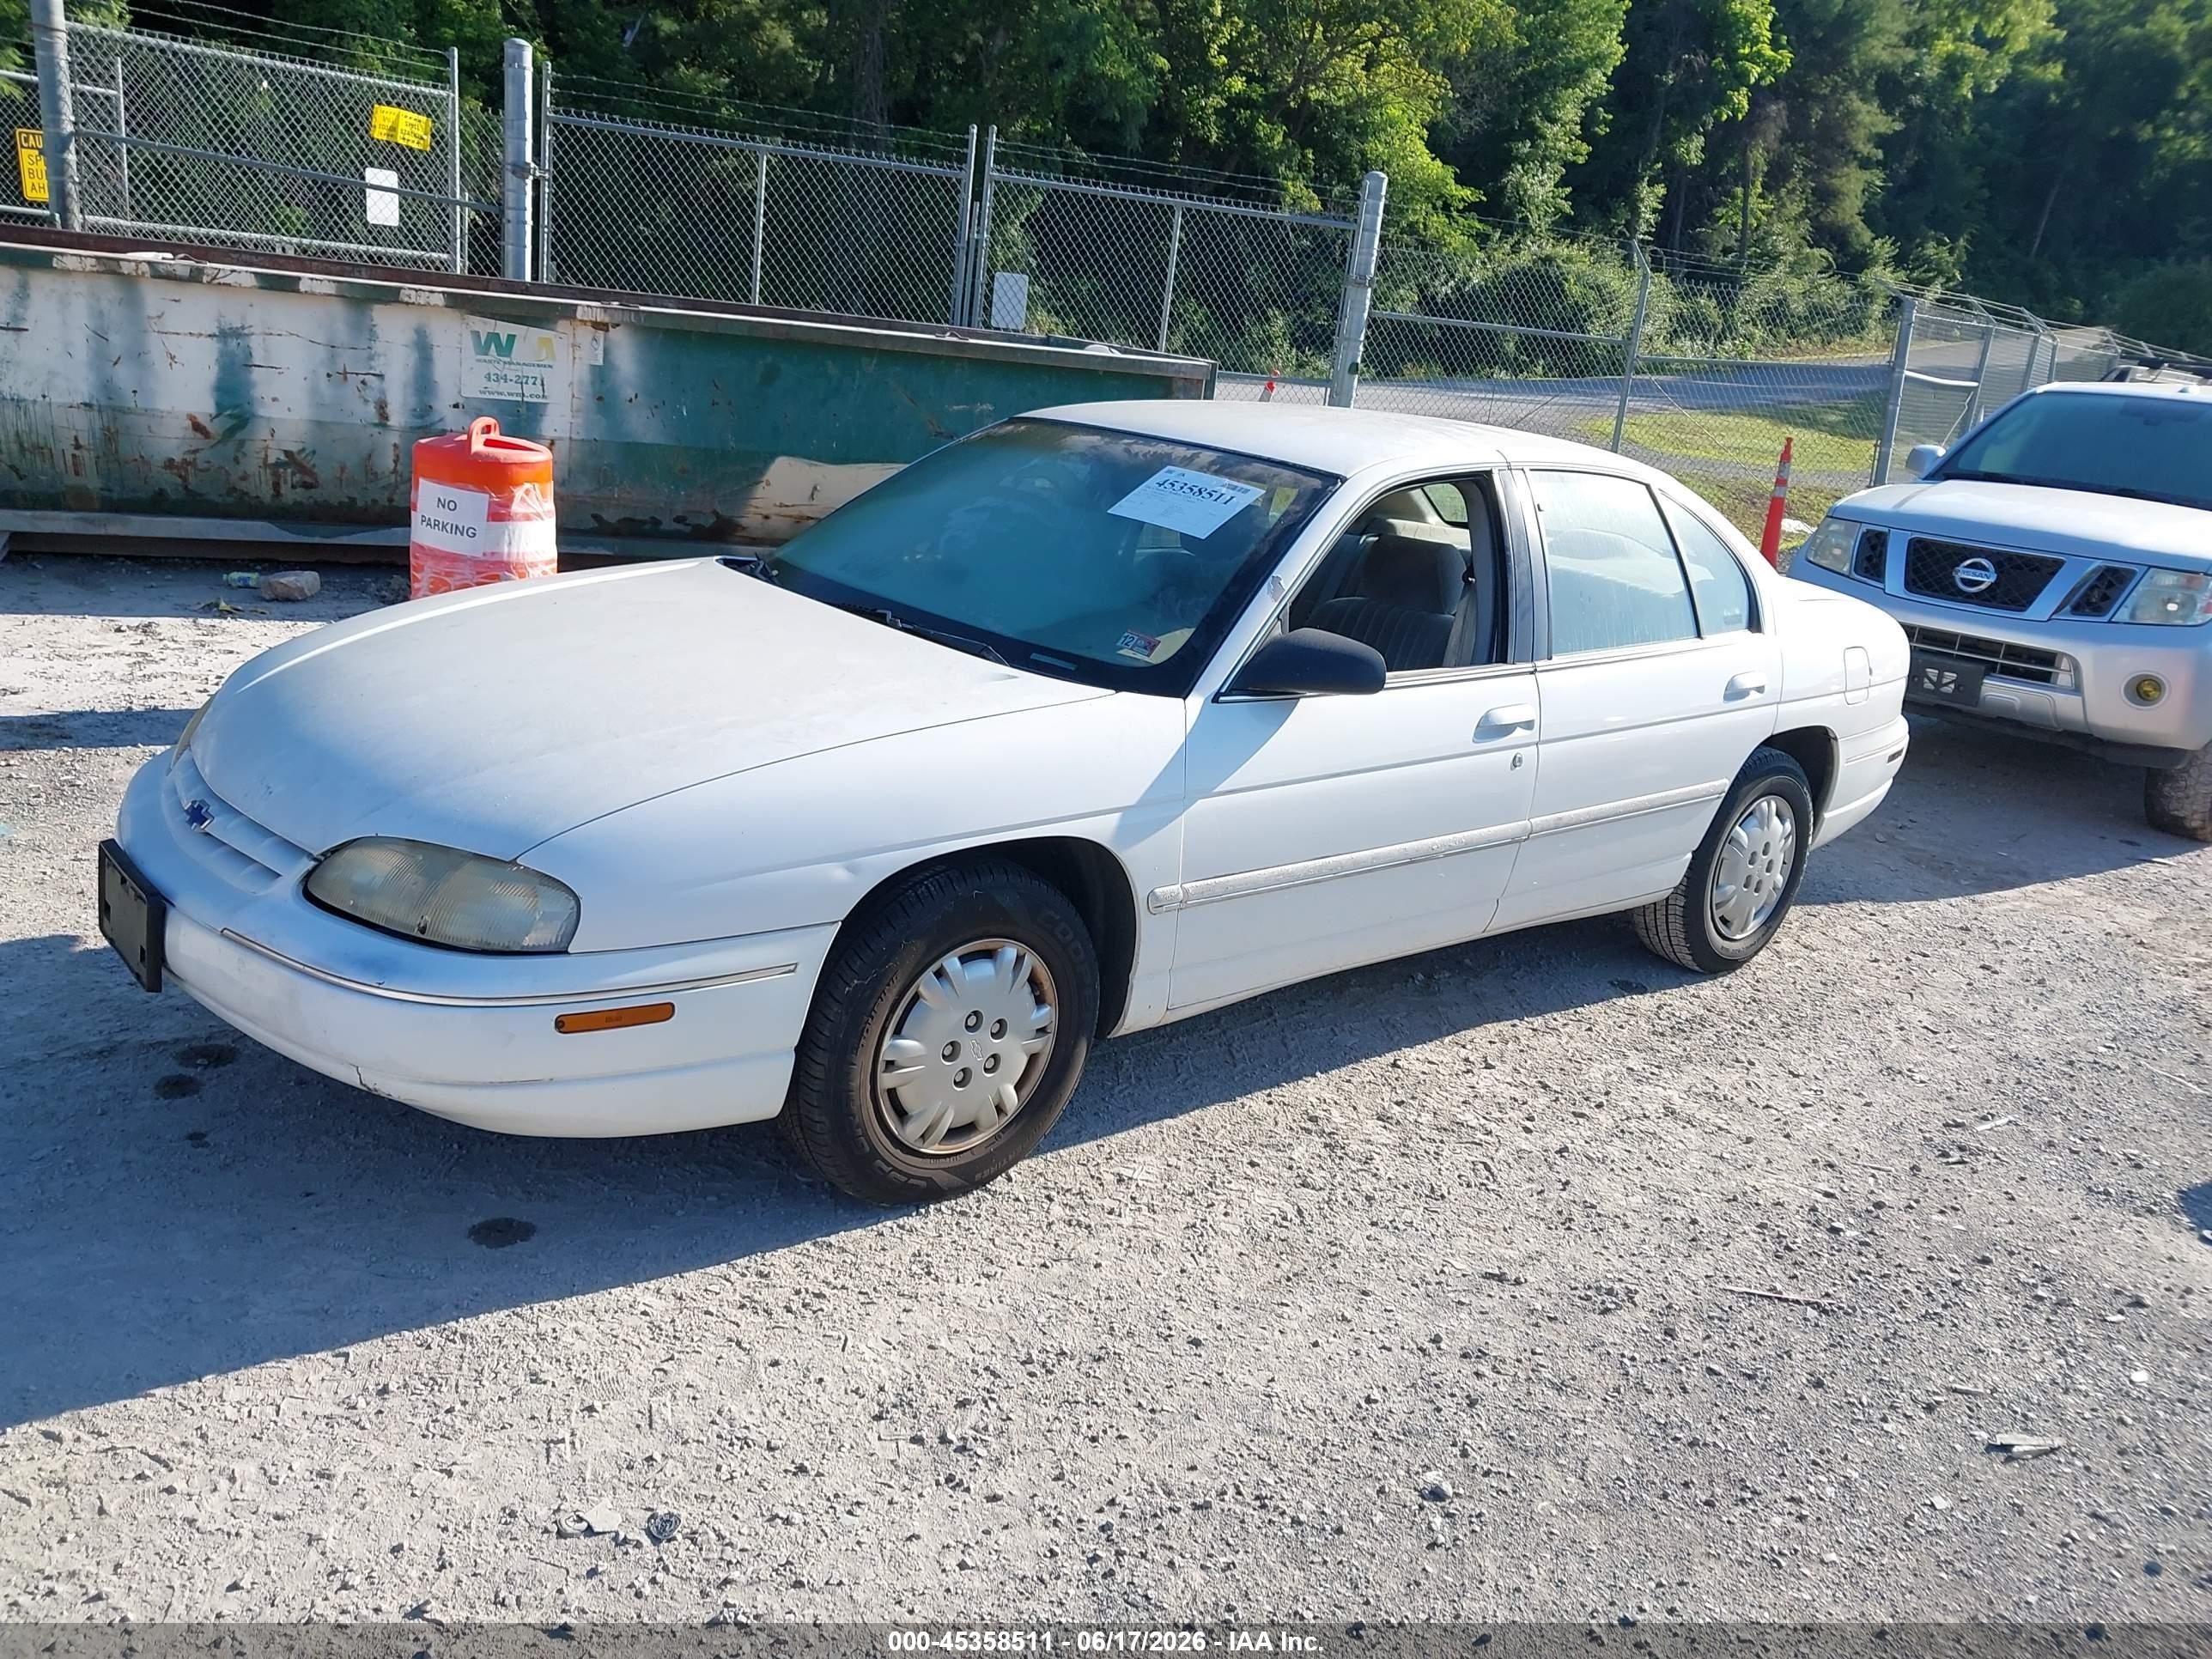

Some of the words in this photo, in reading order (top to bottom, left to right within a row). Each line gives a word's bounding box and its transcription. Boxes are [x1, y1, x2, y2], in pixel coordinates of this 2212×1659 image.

[27, 168, 44, 180] BU
[30, 182, 46, 194] AH
[1155, 478, 1237, 505] 45358511
[436, 496, 458, 512] NO
[420, 514, 477, 538] PARKING
